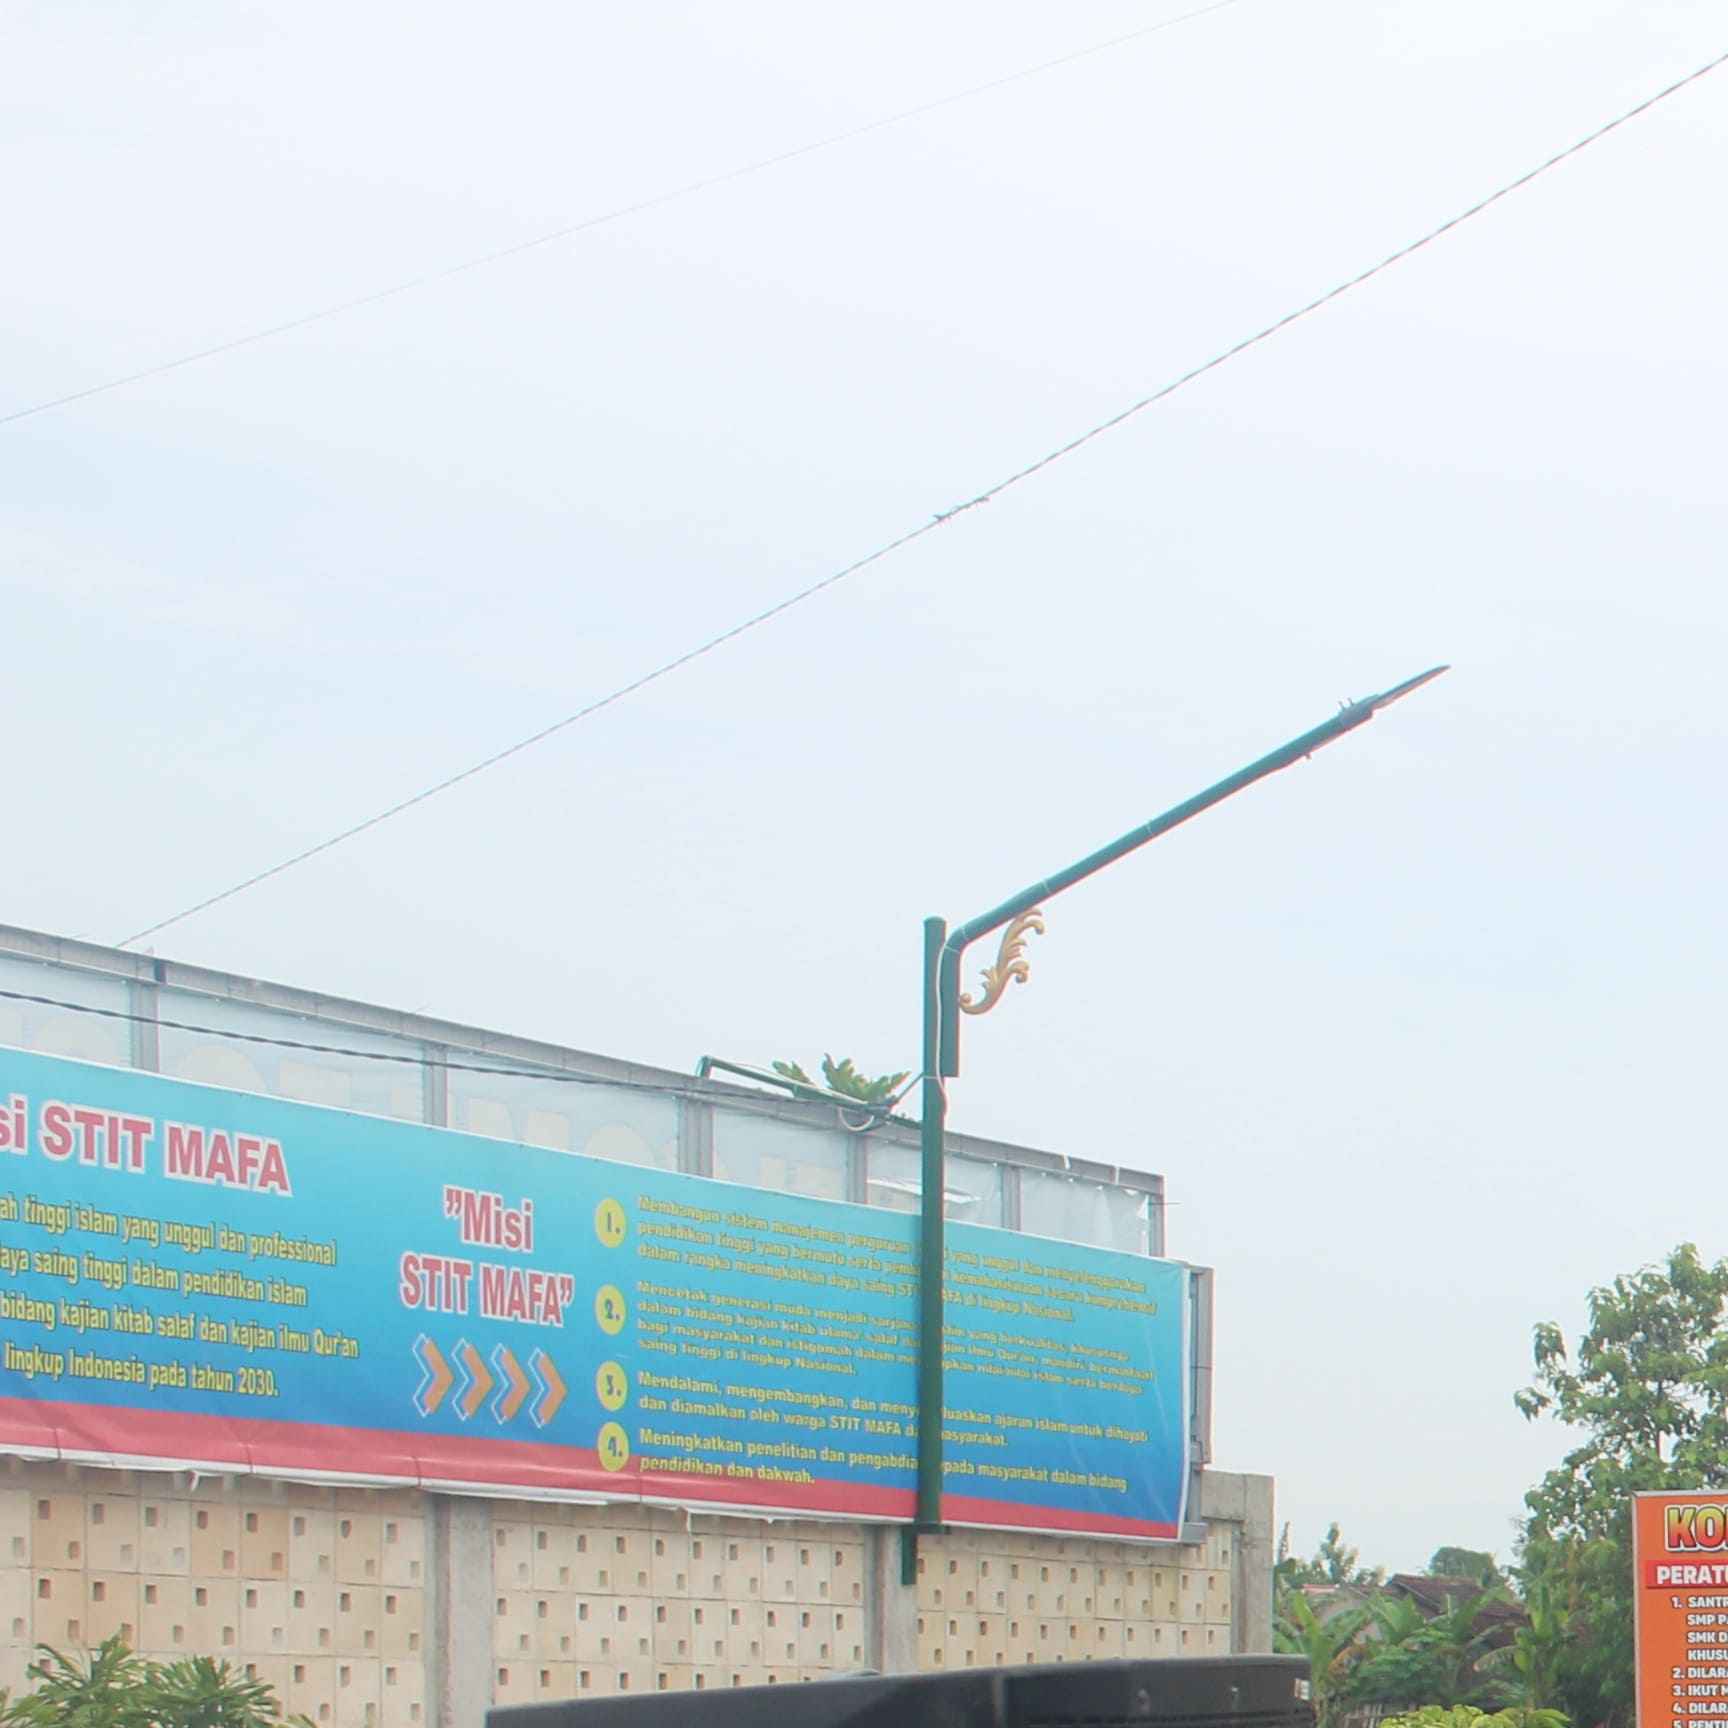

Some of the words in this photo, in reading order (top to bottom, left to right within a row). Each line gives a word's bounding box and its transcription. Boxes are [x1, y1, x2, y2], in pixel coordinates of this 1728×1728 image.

[43, 1103, 153, 1171] STIT
[166, 1123, 290, 1194] MAFA
[24, 1194, 71, 1233] tinggi
[76, 1202, 117, 1235] islam
[123, 1214, 160, 1248] yang
[165, 1221, 214, 1253] unggul
[220, 1224, 245, 1252] dan
[251, 1232, 337, 1266] professional
[607, 1212, 621, 1235] 1.
[35, 1249, 78, 1284] saing
[84, 1250, 127, 1289] tinggi
[132, 1256, 178, 1290] dalam
[183, 1268, 264, 1300] pendidikan
[268, 1276, 307, 1306] islam
[401, 1252, 473, 1313] STIT
[0, 1290, 55, 1331] bidang
[61, 1298, 109, 1333] kajian
[114, 1303, 152, 1334] kitab
[158, 1311, 194, 1339] salaf
[200, 1315, 227, 1343] dan
[231, 1319, 276, 1352] kajian
[279, 1322, 309, 1352] ilmu
[313, 1328, 359, 1358] Qur'an
[604, 1298, 621, 1321] 2.
[4, 1340, 64, 1381] lingkup
[69, 1349, 145, 1383] Indonesia
[151, 1361, 187, 1392] pada
[193, 1363, 233, 1392] tahun
[238, 1367, 278, 1396] 2030.
[606, 1381, 622, 1397] 3.
[638, 1370, 721, 1397] Mendalami,
[727, 1382, 848, 1410] mengembangkan,
[851, 1397, 876, 1413] dan
[639, 1396, 666, 1411] dan
[671, 1397, 746, 1420] diamalkan
[750, 1410, 780, 1423] oleh
[783, 1414, 826, 1431] warga
[830, 1416, 860, 1431] STIT
[864, 1418, 901, 1435] MAFA
[941, 1429, 1009, 1448] asyarakat.
[639, 1427, 743, 1453] Meningkatkan
[746, 1440, 817, 1461] penelitian
[820, 1447, 846, 1462] dan
[848, 1450, 919, 1470] pengabdia
[978, 1464, 1048, 1482] masyarakat
[639, 1456, 722, 1476] pendidikan
[727, 1463, 753, 1479] dan
[758, 1466, 816, 1484] dakwah.
[1672, 1596, 1683, 1608] 1.
[1687, 1613, 1715, 1626] SMP
[1687, 1631, 1717, 1644] SMK
[1672, 1667, 1685, 1679] 2.
[1672, 1685, 1685, 1697] 3.
[1687, 1684, 1719, 1696] IKUT
[1672, 1703, 1685, 1715] 4.
